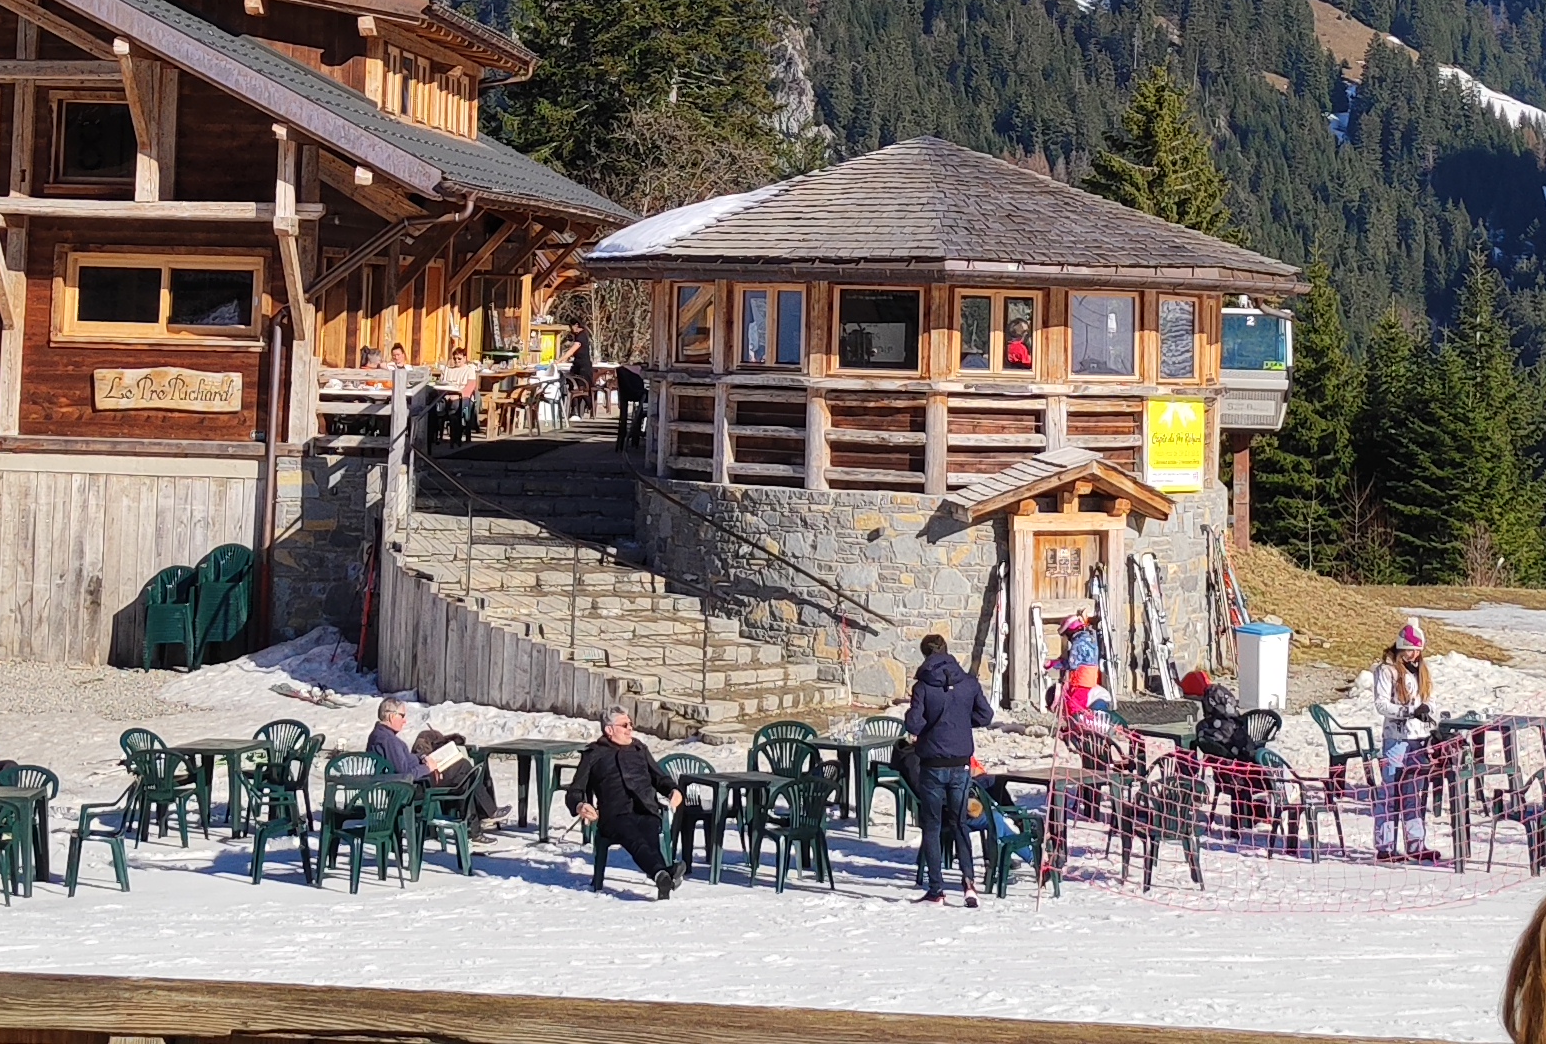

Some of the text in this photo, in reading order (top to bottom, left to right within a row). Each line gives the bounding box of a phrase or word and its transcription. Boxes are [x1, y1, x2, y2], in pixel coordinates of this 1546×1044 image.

[1246, 316, 1255, 326] 2
[103, 373, 234, 402] Le Pré Richard
